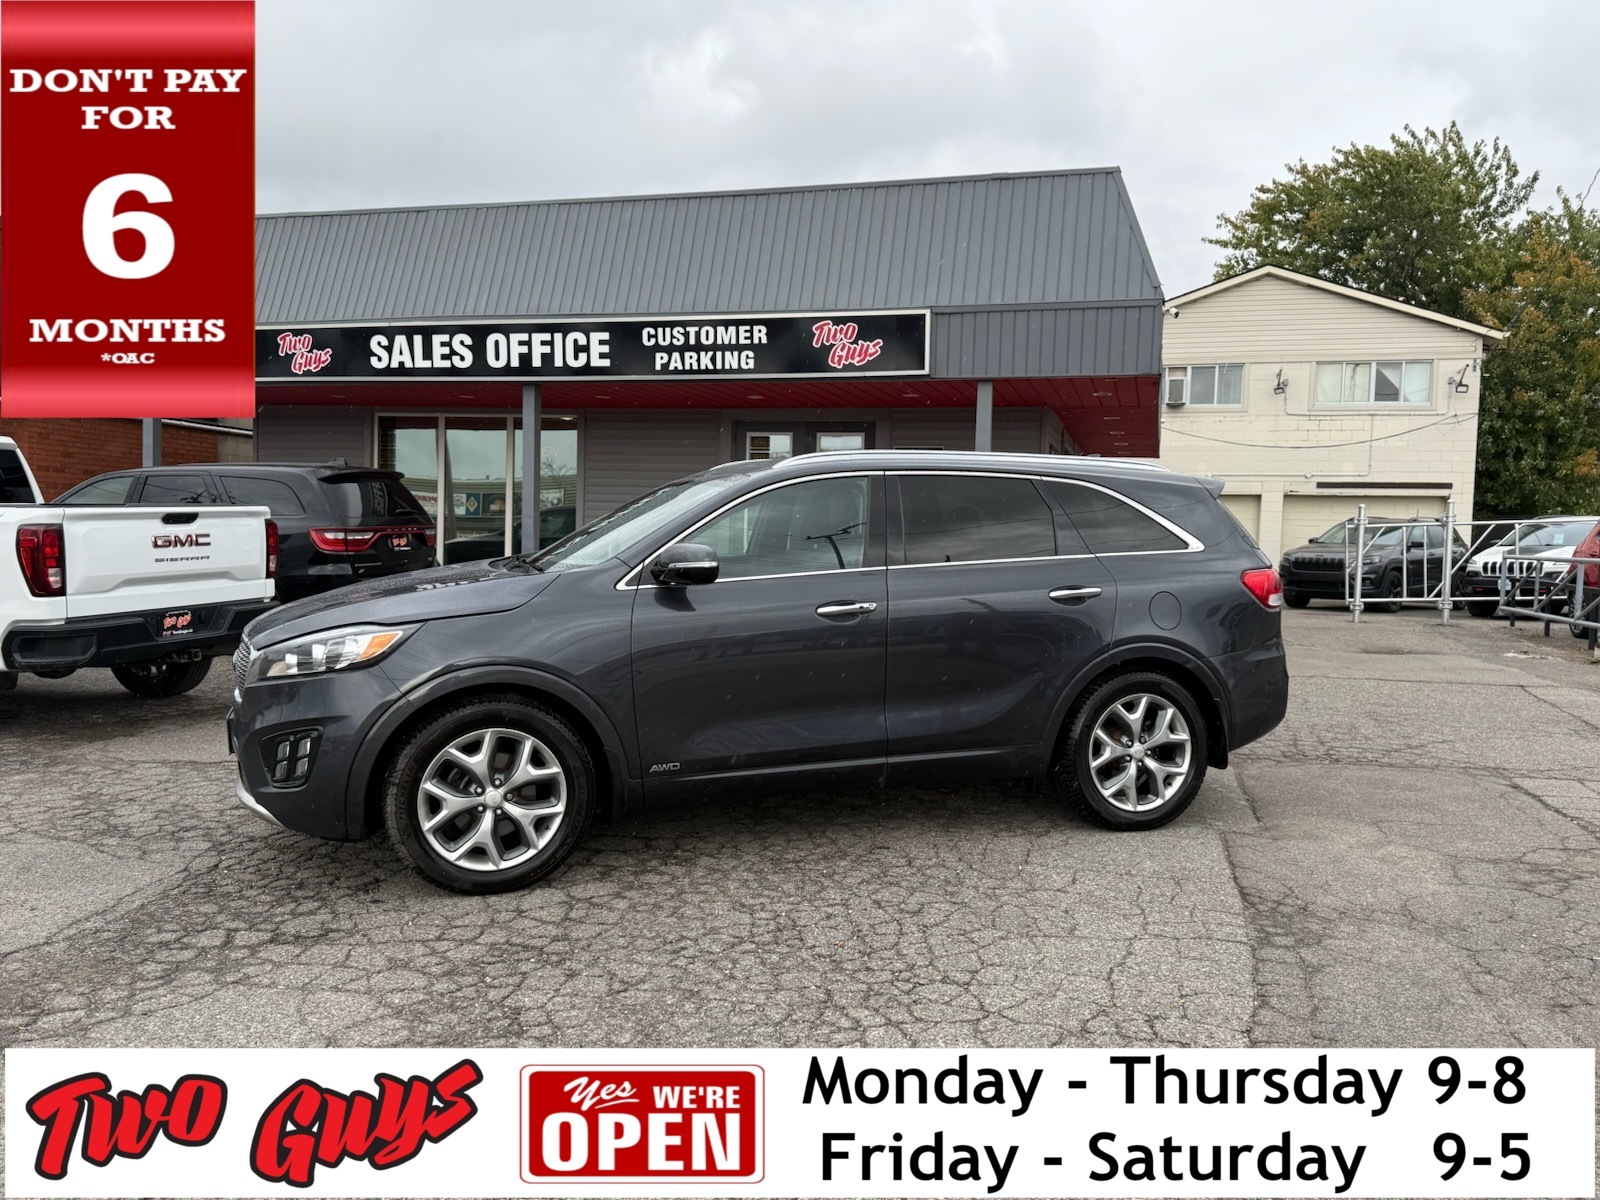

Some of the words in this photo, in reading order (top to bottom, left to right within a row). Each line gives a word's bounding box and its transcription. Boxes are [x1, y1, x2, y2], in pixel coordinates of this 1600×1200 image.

[278, 333, 312, 356] Two
[642, 325, 767, 346] CUSTOMER
[812, 320, 858, 347] Two
[291, 349, 332, 374] Guys
[369, 334, 473, 369] SALES
[486, 332, 611, 368] OFFICE
[655, 351, 755, 371] PARKING
[828, 339, 883, 368] Guys
[151, 533, 211, 549] GMC
[649, 762, 681, 773] AWD
